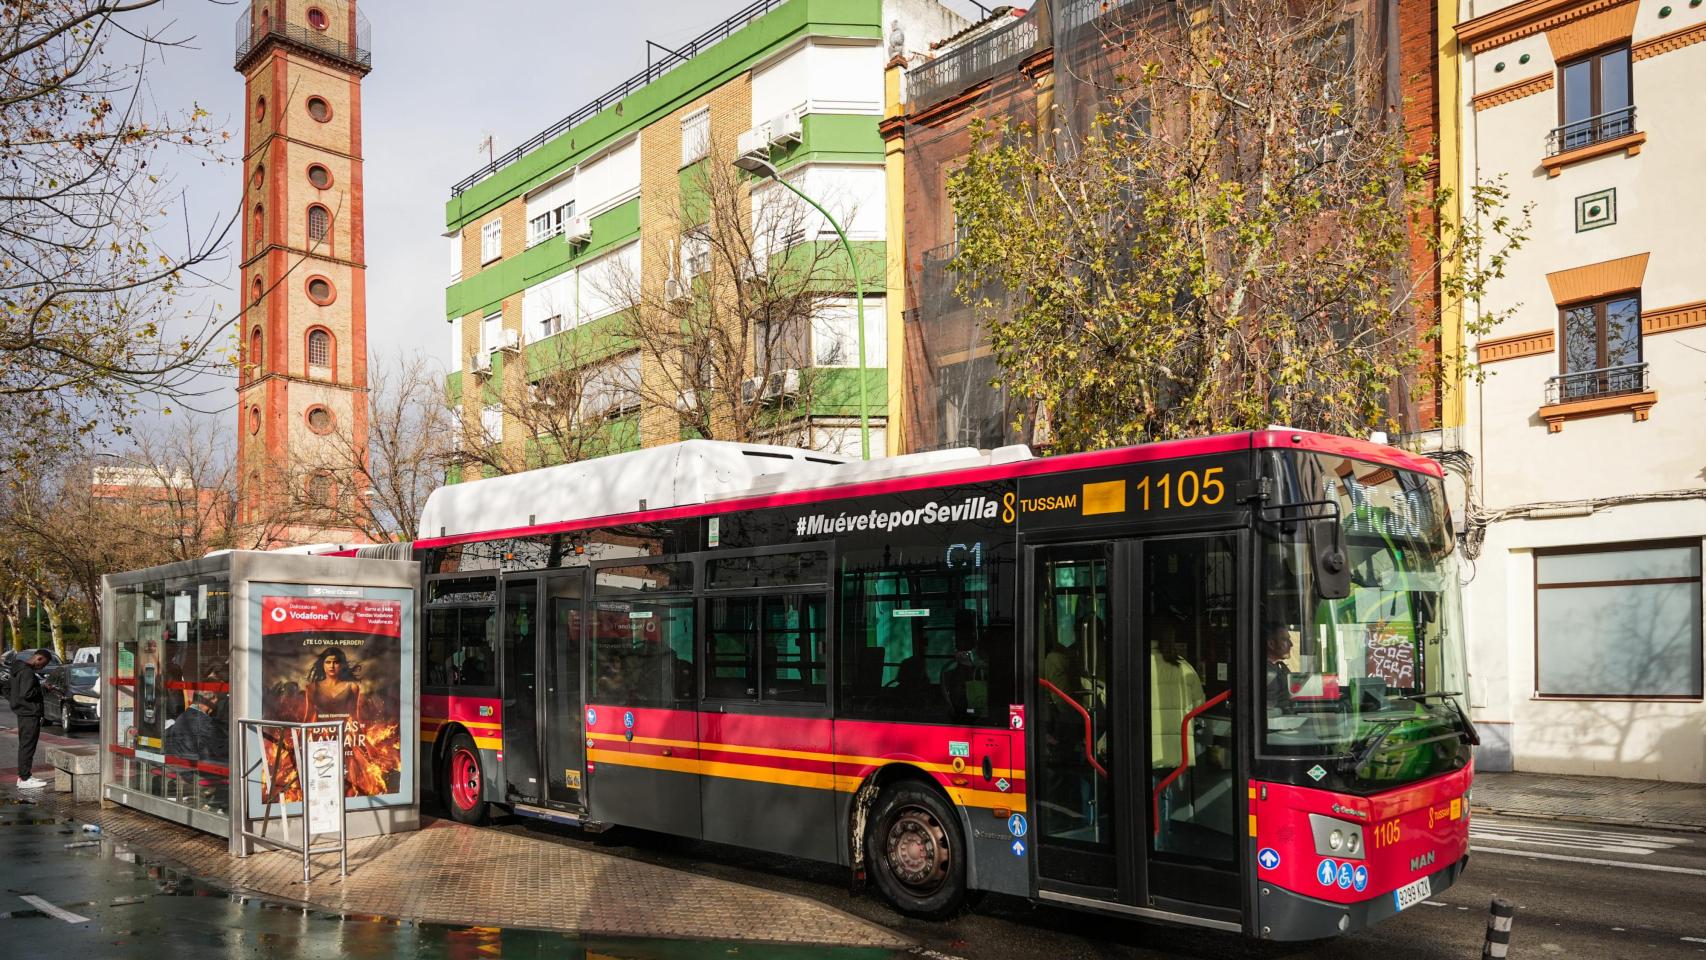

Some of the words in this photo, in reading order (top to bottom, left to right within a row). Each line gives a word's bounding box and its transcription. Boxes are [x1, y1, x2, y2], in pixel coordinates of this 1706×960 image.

[1136, 467, 1225, 511] 1105
[1020, 494, 1077, 513] TUSSAM
[796, 496, 998, 536] #MuéveteporSevilla
[946, 542, 981, 568] C1
[290, 611, 328, 620] Vodafone
[329, 612, 340, 621] TV
[303, 639, 313, 647] ¿TE
[313, 721, 359, 734] BRUAS
[1374, 819, 1401, 849] 1105
[1410, 852, 1434, 871] MAN
[1399, 885, 1416, 906] 9299
[1416, 880, 1431, 897] KZK
